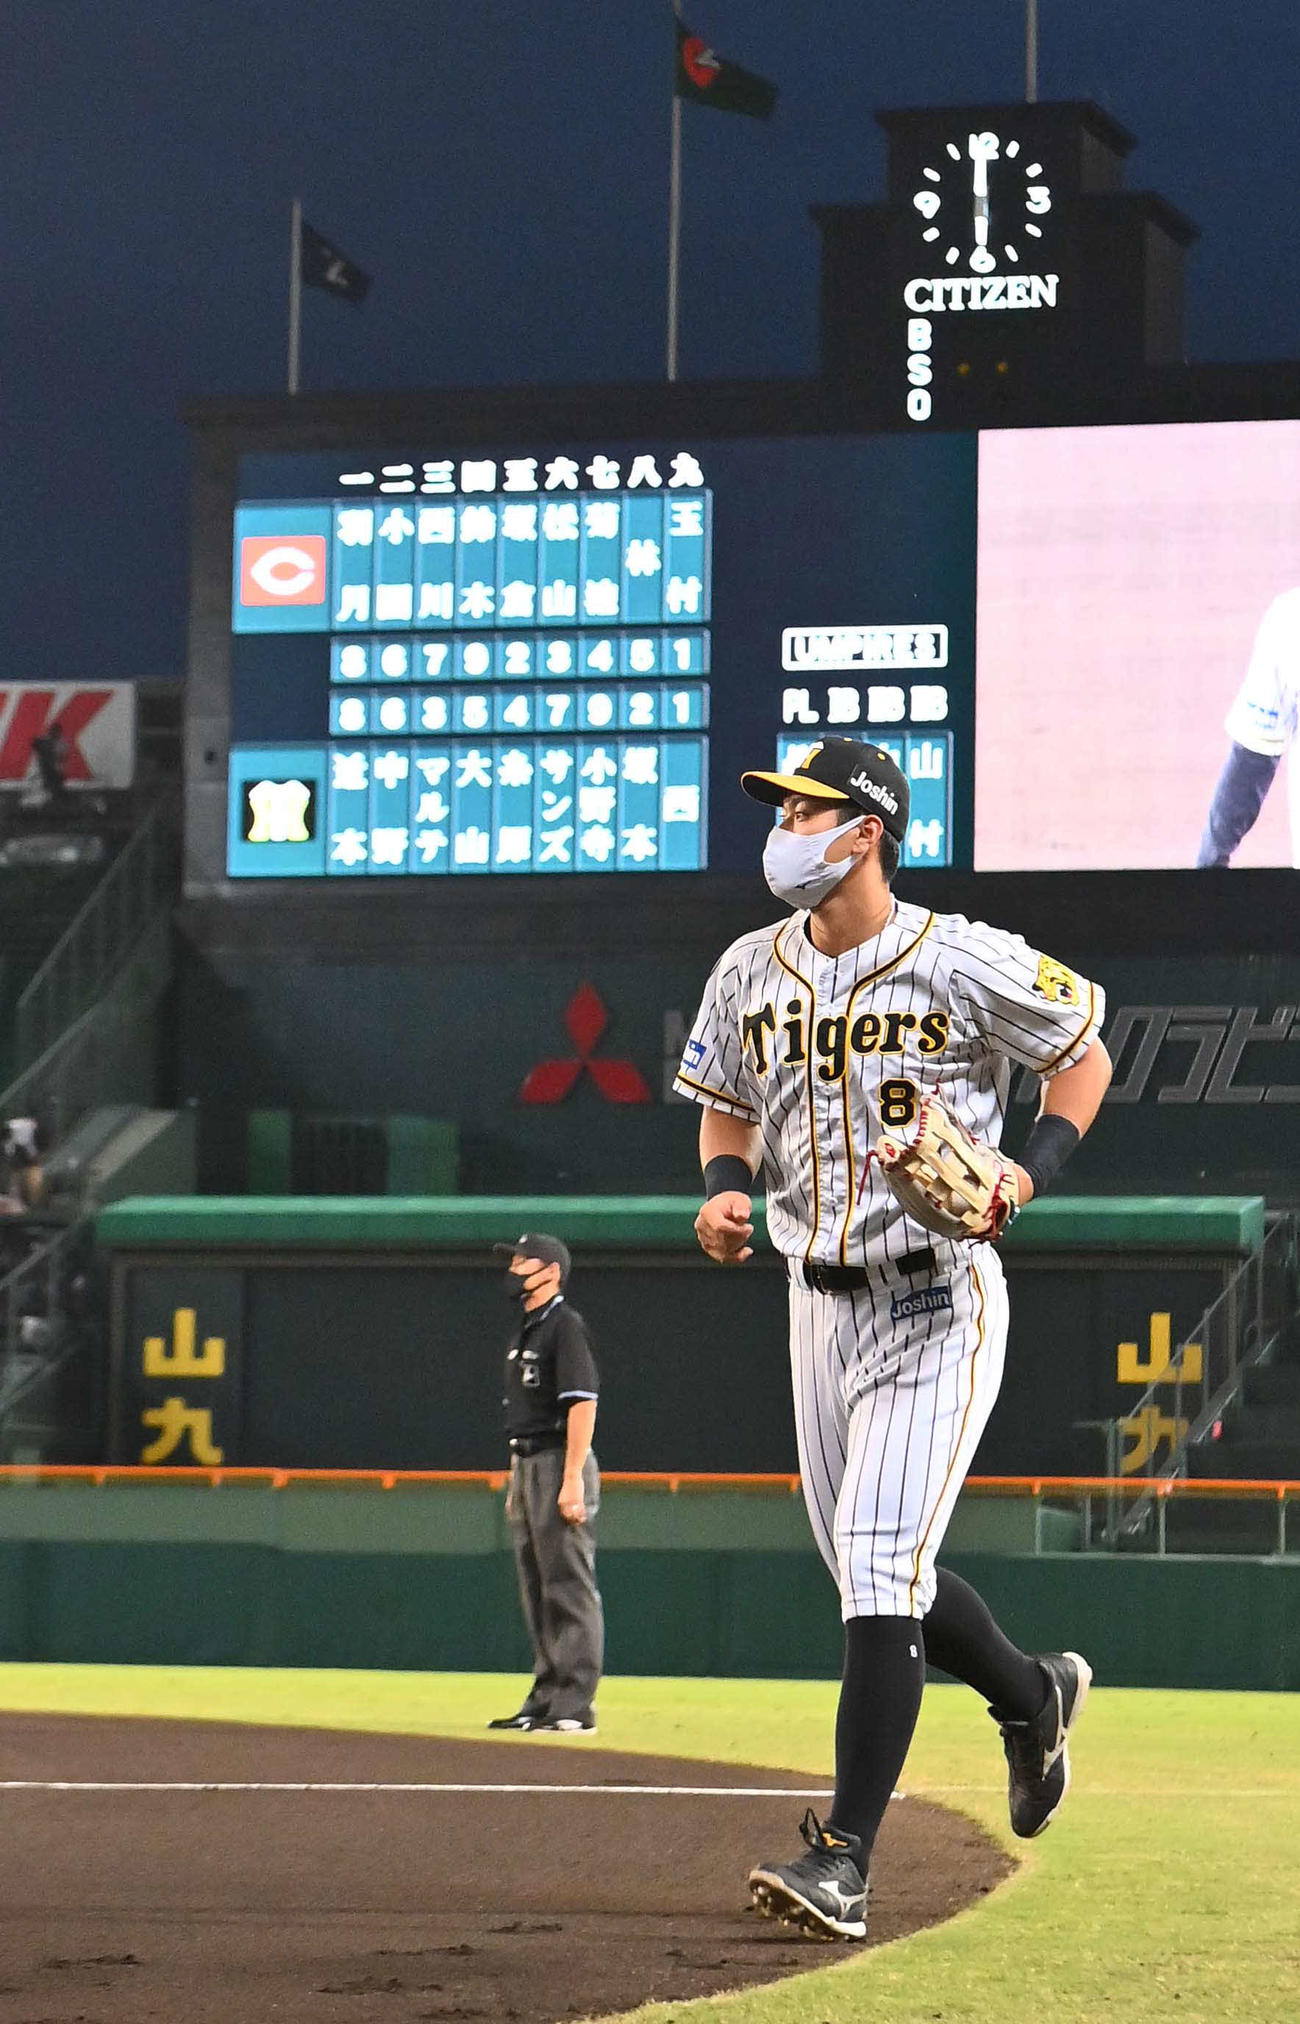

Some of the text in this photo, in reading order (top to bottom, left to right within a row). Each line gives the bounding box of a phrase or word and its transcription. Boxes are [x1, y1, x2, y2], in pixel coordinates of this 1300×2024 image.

[969, 132, 1000, 160] 12
[913, 191, 941, 219] 9
[1026, 186, 1051, 214] 3
[969, 245, 996, 273] 6
[904, 274, 1059, 313] CITIZEN
[424, 644, 446, 675] 7
[506, 642, 529, 673] 2
[588, 641, 612, 671] 4
[674, 639, 689, 669] 1
[504, 696, 527, 726] 4
[547, 695, 569, 726] 7
[630, 693, 652, 724] 2
[673, 693, 688, 723] 1
[0, 690, 115, 780] K
[455, 749, 491, 864] 大山
[850, 771, 899, 815] Joshin
[741, 998, 951, 1084] Tigers
[878, 1077, 920, 1129] 8
[891, 1290, 950, 1319] Joshin
[142, 1307, 226, 1467] 山九
